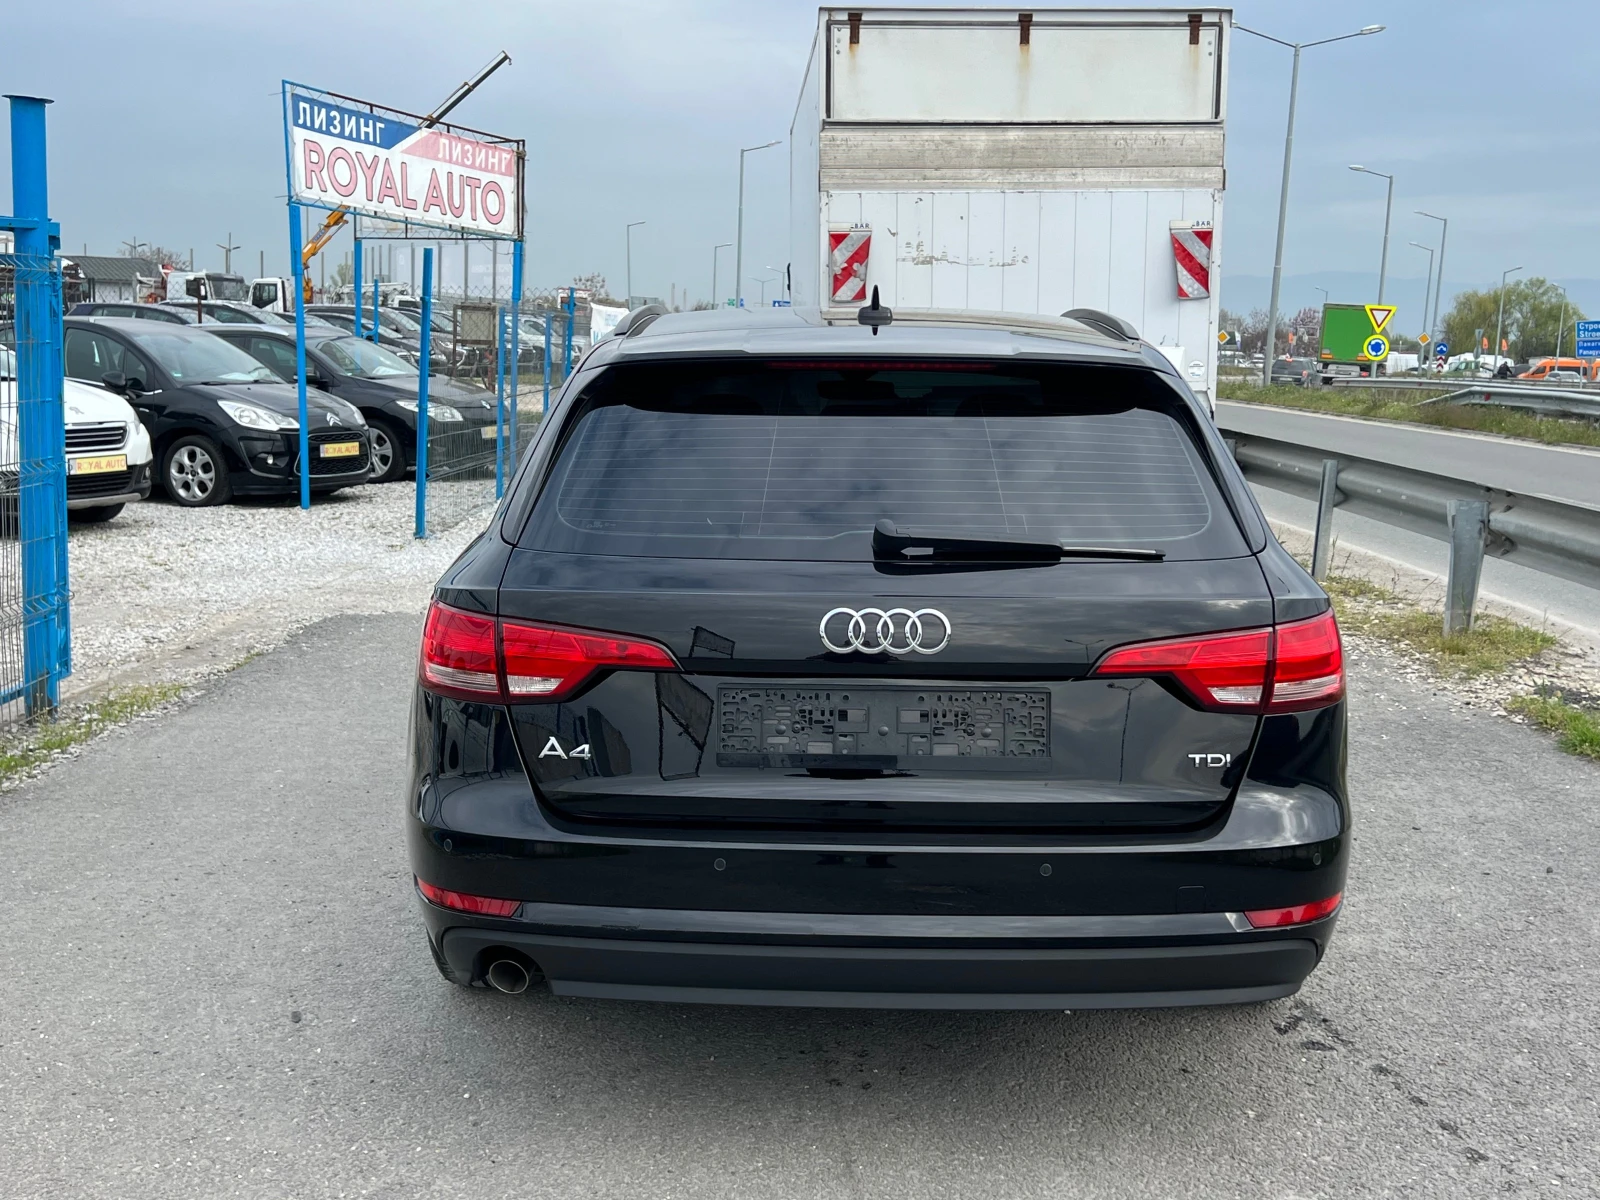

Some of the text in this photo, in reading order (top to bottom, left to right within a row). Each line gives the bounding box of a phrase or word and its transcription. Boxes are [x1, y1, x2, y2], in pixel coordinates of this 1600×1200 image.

[298, 101, 385, 144] ЛИЗИНГ
[437, 138, 511, 173] ЛИЗИНГ
[303, 138, 505, 225] ROYAL AUTO
[1579, 322, 1600, 331] Стро
[538, 736, 591, 760] A4
[1187, 753, 1231, 768] TDI
